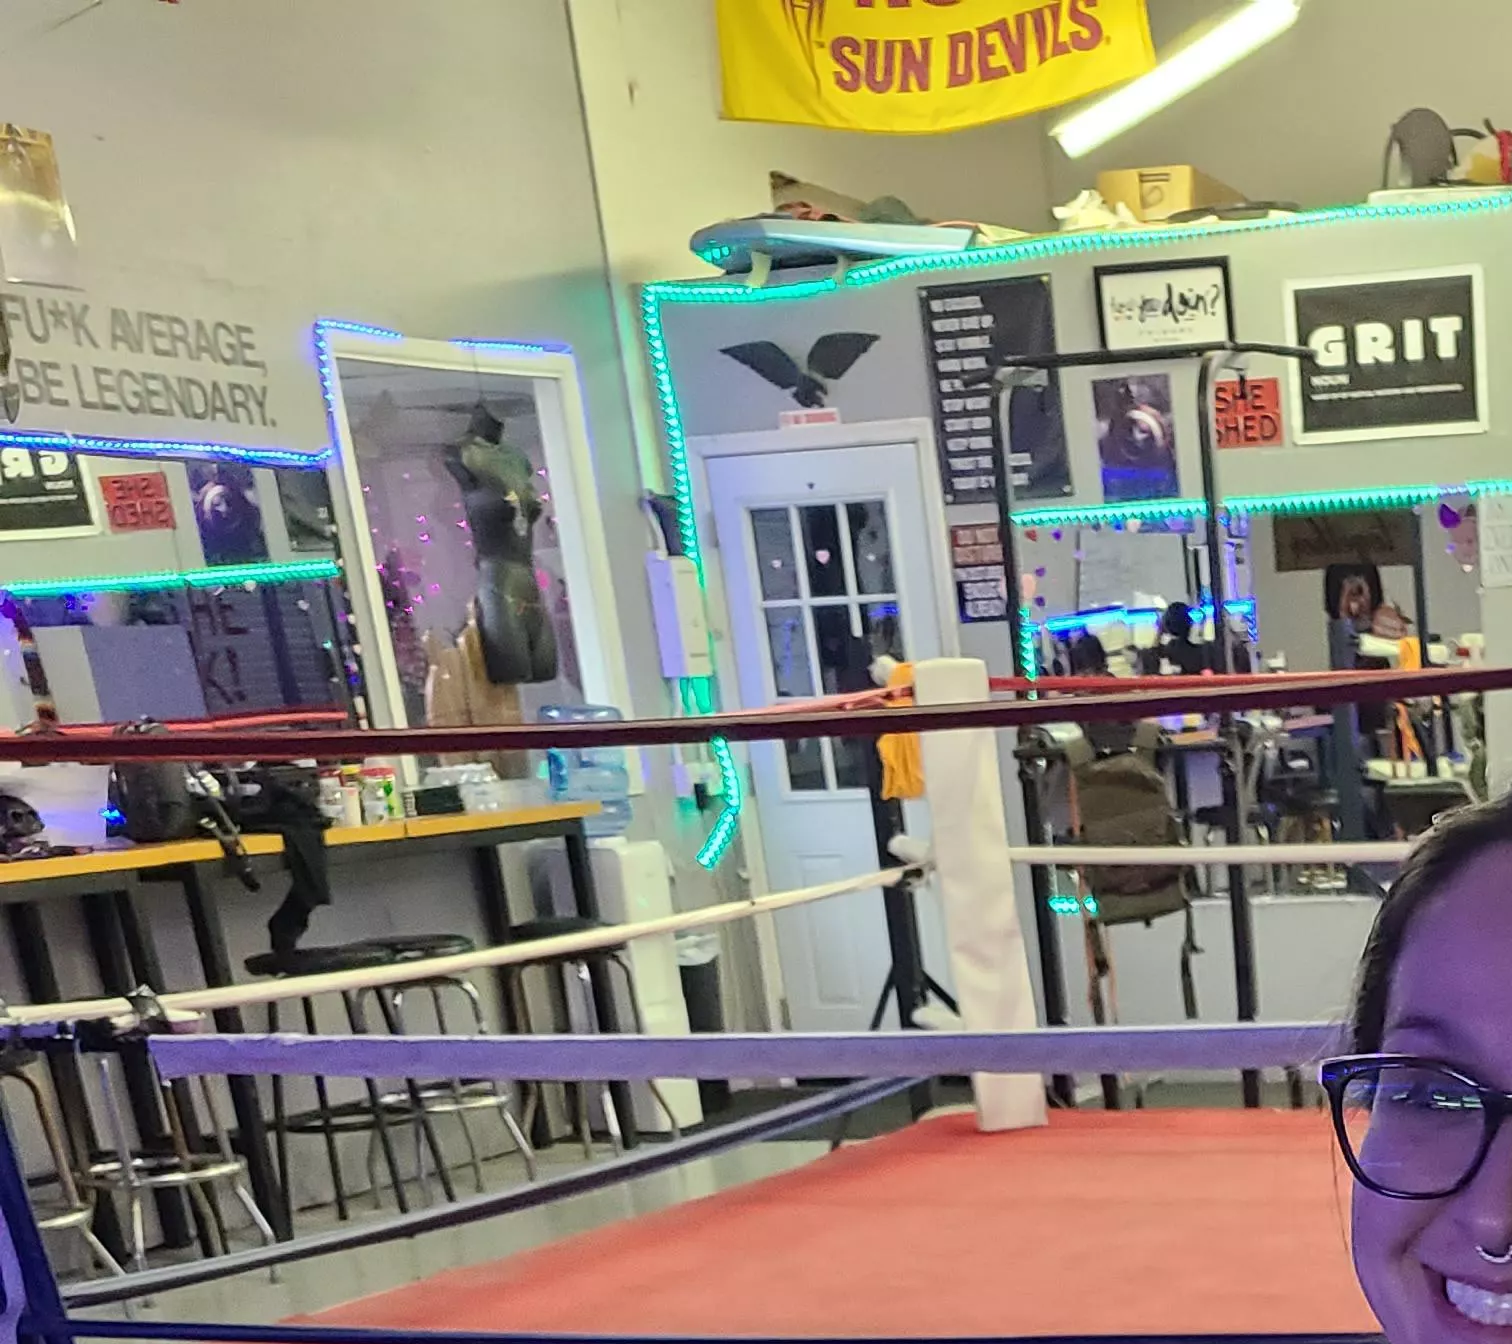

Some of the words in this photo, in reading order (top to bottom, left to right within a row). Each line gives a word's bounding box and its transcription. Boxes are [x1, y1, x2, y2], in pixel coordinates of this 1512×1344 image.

[831, 35, 931, 94] SUN
[947, 0, 1103, 88] DEVILS
[110, 307, 268, 377] AVERAGE,
[1308, 315, 1463, 368] GRIT
[15, 357, 70, 407] BE
[71, 363, 278, 428] LEGENDARY.
[1215, 385, 1266, 413] SHE
